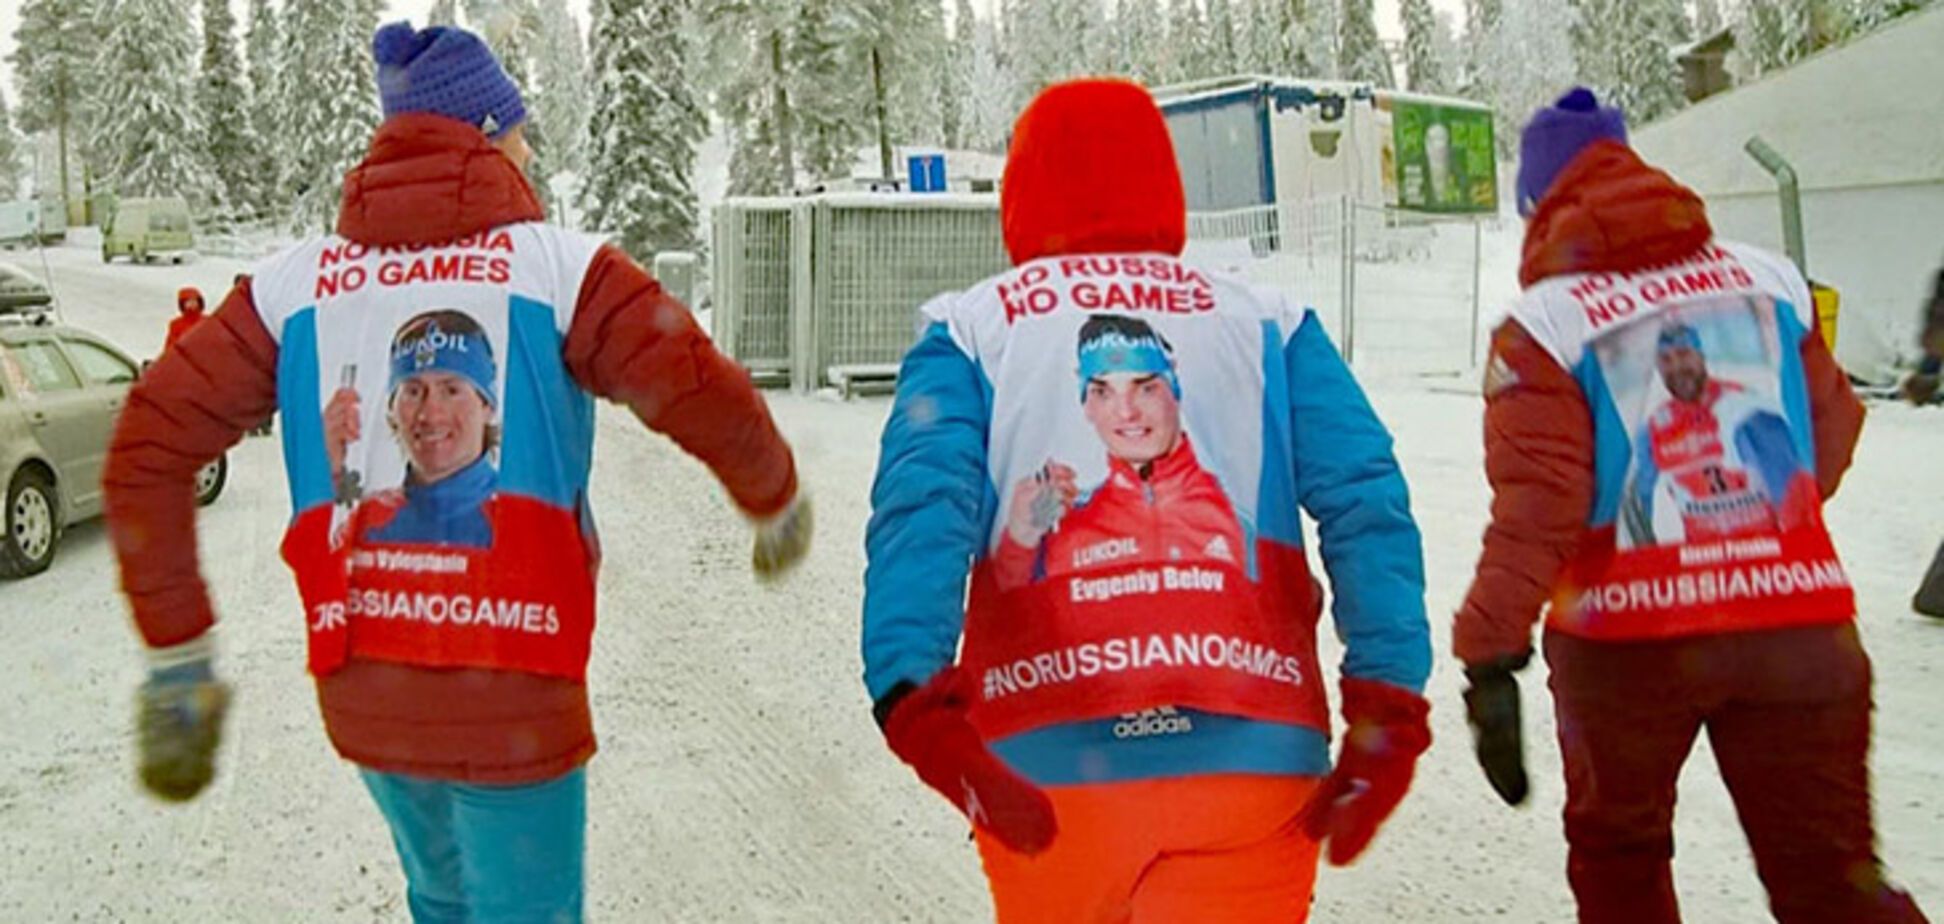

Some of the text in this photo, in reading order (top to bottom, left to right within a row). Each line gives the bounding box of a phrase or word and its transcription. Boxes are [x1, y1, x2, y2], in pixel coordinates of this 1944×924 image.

[319, 240, 368, 268] NO
[1060, 256, 1212, 289] RUSSIA
[315, 254, 511, 299] NO GAMES
[1003, 281, 1216, 326] NO GAMES
[1585, 292, 1637, 329] NO
[1702, 464, 1729, 495] 3
[1070, 565, 1225, 602] Evgeniy Belov
[982, 633, 1304, 700] #NORUSSIANOGAMES
[1112, 713, 1193, 739] adidas
